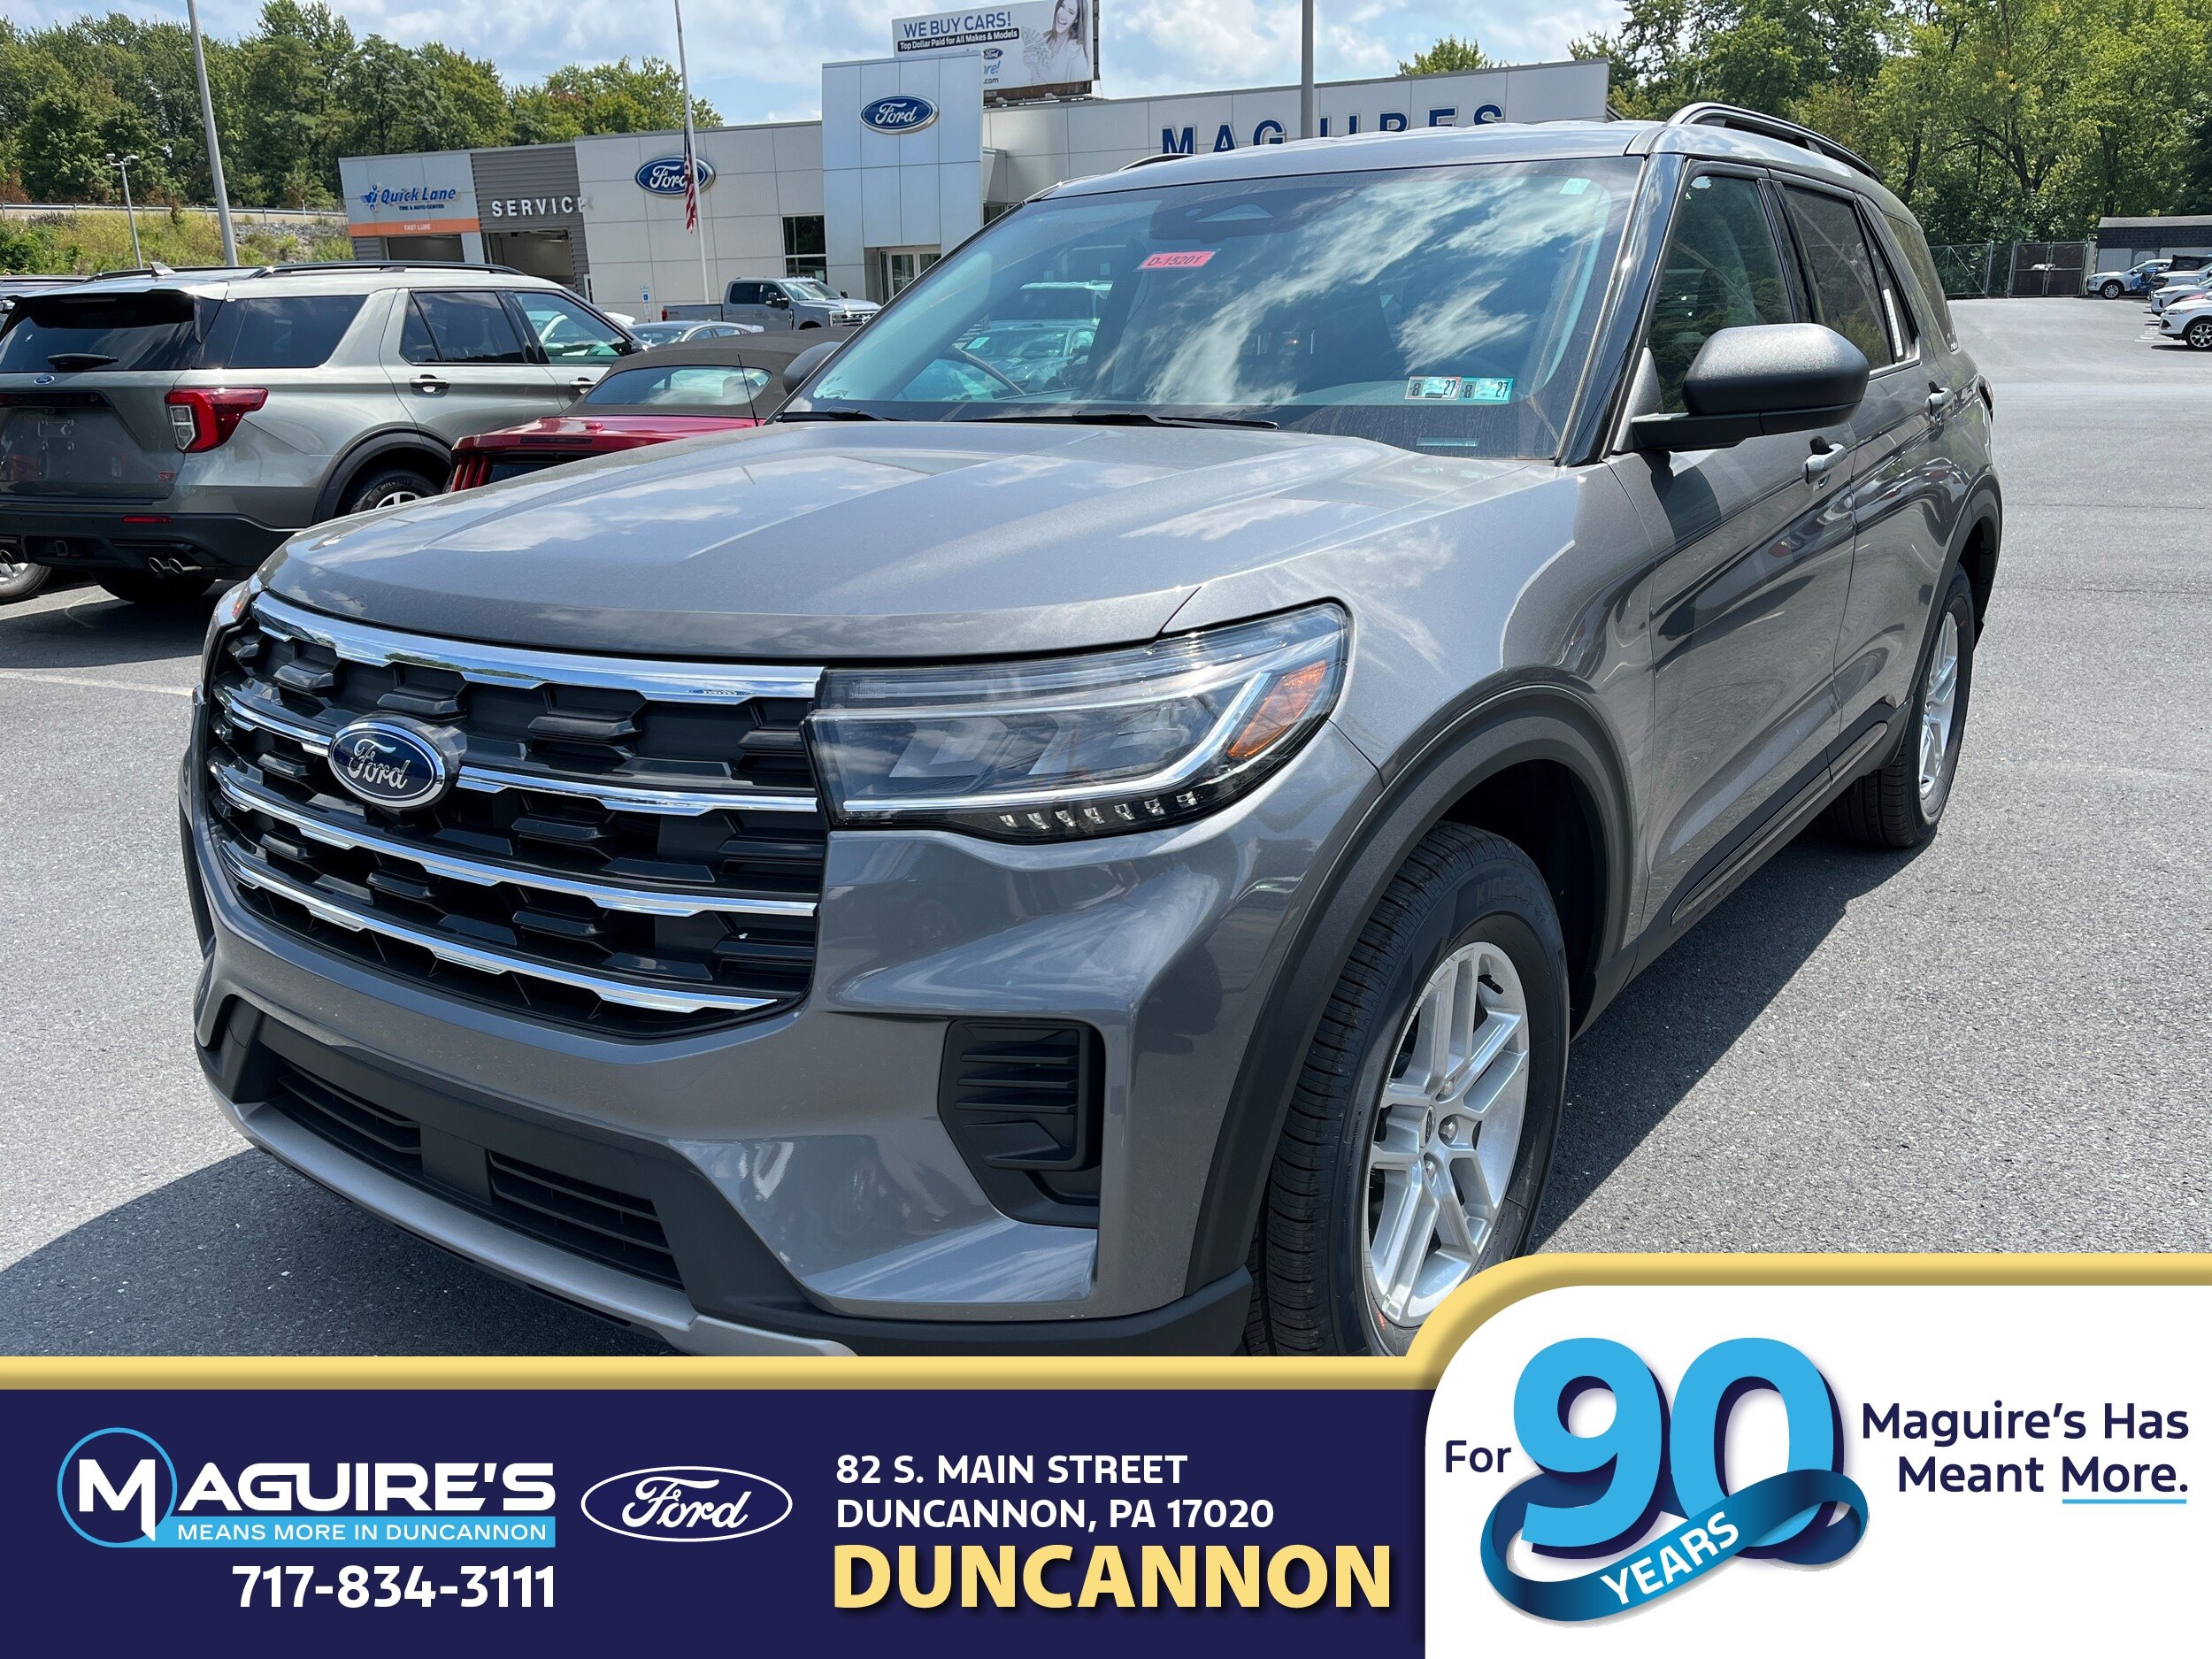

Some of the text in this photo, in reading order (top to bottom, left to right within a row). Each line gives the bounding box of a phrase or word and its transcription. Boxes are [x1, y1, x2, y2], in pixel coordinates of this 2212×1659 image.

[903, 12, 1011, 38] WE BUY CARS!
[900, 42, 911, 50] Top
[912, 40, 931, 49] Dollar
[931, 38, 946, 47] Paid
[956, 35, 965, 44] All
[965, 33, 987, 42] Makes
[993, 30, 1018, 40] Models
[875, 103, 917, 124] Ford
[380, 187, 457, 204] Quick Lane
[1147, 255, 1203, 266] D-15201
[1443, 380, 1456, 396] 27
[1495, 381, 1509, 398] 27
[347, 738, 411, 789] Ford
